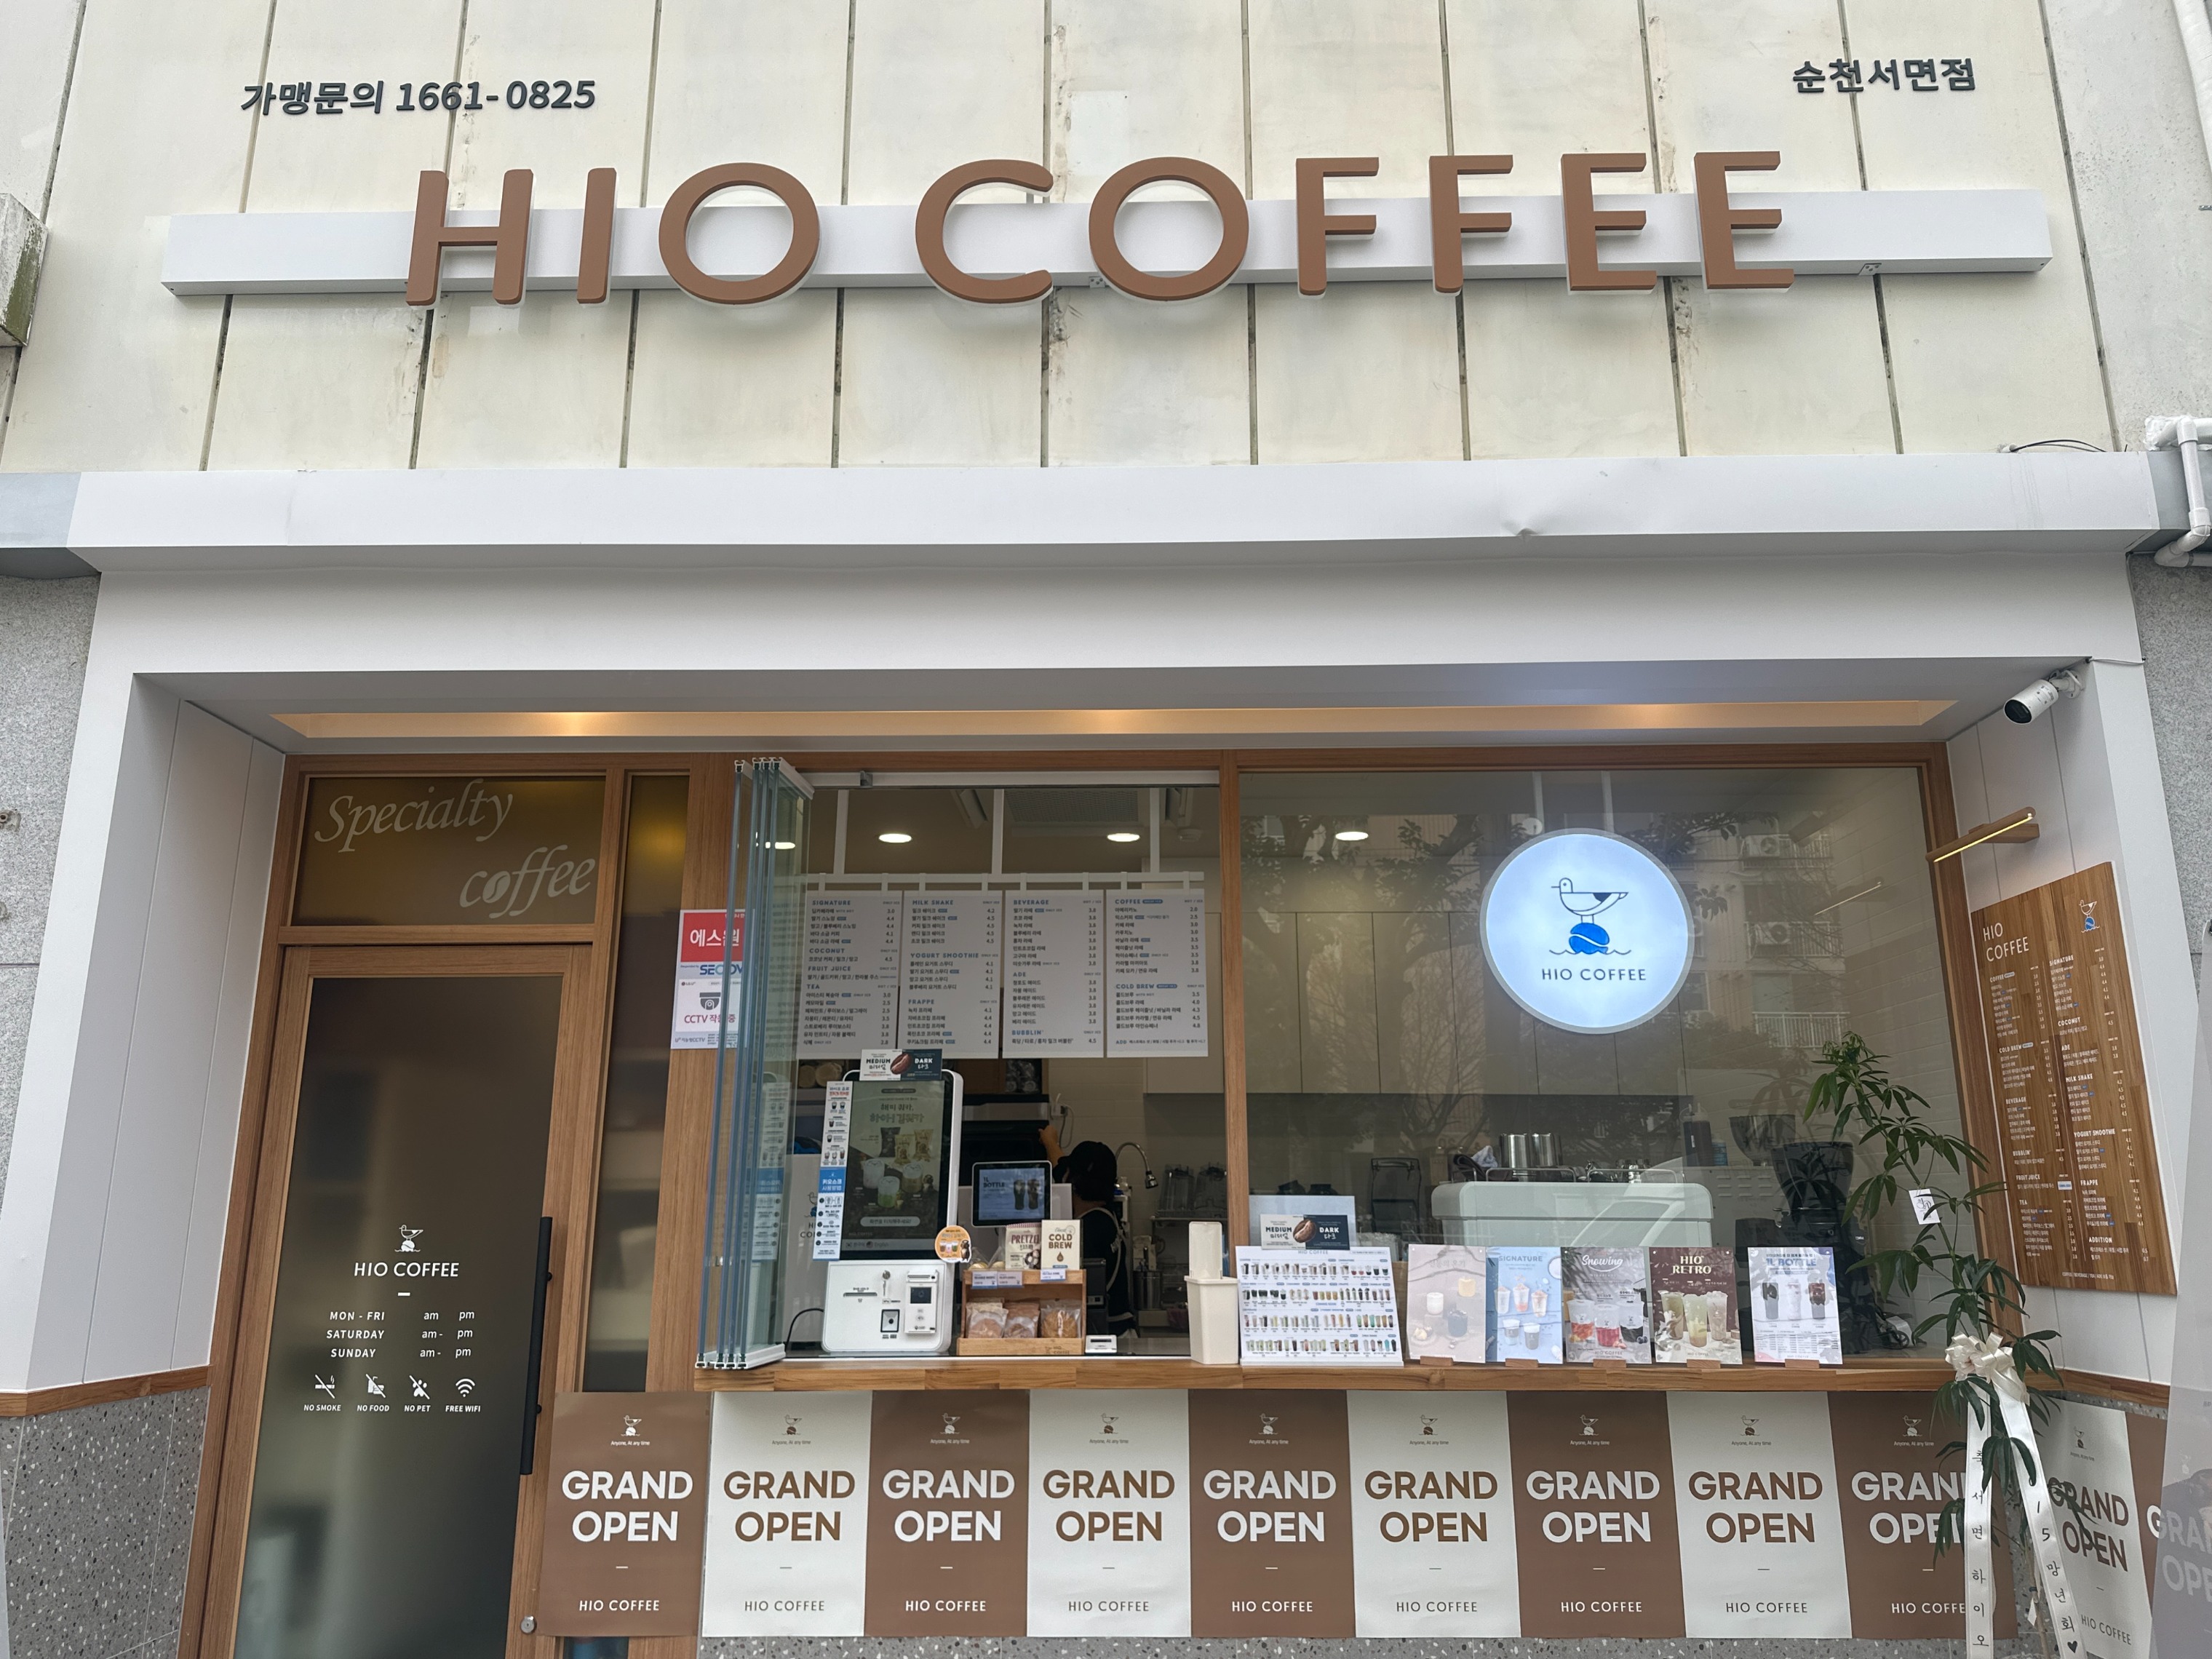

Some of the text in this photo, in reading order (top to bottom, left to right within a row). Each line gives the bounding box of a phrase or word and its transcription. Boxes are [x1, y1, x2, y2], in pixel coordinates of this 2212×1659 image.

[1792, 57, 1976, 93] 순천서면점
[240, 79, 384, 116] 가맹문의
[405, 150, 1796, 307] HIO COFFEE
[314, 778, 514, 854] Specialty
[459, 844, 596, 919] coffee
[1983, 922, 2003, 942] HIO
[1986, 936, 2029, 962] COFFEE
[2049, 955, 2074, 966] SIGNATURE
[1542, 968, 1647, 981] HIO COFFEE
[1989, 974, 2005, 983] COFFEE
[684, 1014, 736, 1024] CCTV 작중
[2058, 1017, 2081, 1027] COCONUT
[1999, 1046, 2010, 1054] COLD
[2005, 1097, 2026, 1105] BEVERAGE
[2074, 1129, 2115, 1138] YOGURT SMOOTHIE
[1049, 1233, 1073, 1241] COLD
[1049, 1241, 1073, 1249] BREW
[354, 1262, 460, 1277] HIO COFFEE
[1581, 1254, 1623, 1272] Snowing
[1673, 1265, 1711, 1274] RETRO
[1778, 1258, 1816, 1266] BOTTLE
[330, 1311, 475, 1321] MON FRI am pm
[326, 1329, 473, 1340] SATURDAY am pm
[330, 1348, 472, 1358] SUNDAY am pm
[404, 1404, 431, 1412] NO PET
[562, 1470, 693, 1500] GRAND
[723, 1470, 856, 1500] GRAND
[883, 1469, 1015, 1500] GRAND
[1043, 1469, 1175, 1499] GRAND
[1203, 1469, 1337, 1500] GRAND
[1364, 1470, 1498, 1500] GRAND
[1526, 1471, 1660, 1500] GRAND
[1688, 1471, 1823, 1500] GRAND
[1851, 1471, 1966, 1501] GRAN
[2048, 1476, 2129, 1527] GRAND
[572, 1511, 678, 1543] OPEN
[735, 1511, 841, 1542] OPEN
[894, 1510, 1001, 1543] OPEN
[1056, 1511, 1162, 1542] OPEN
[1217, 1511, 1325, 1543] OPEN
[1380, 1511, 1488, 1543] OPEN
[1542, 1511, 1651, 1543] OPEN
[1706, 1512, 1815, 1543] OPEN
[2062, 1521, 2128, 1572] OPEN
[579, 1599, 660, 1611] HIO COFFEE
[744, 1600, 825, 1612] HIO COFFEE
[905, 1599, 986, 1612] HIO COFFEE
[1068, 1600, 1150, 1612] HIO COFFEE
[1232, 1600, 1313, 1612] HIO COFFEE
[1396, 1601, 1478, 1612] HIO COFFEE
[1561, 1601, 1642, 1612] HIO COFFEE
[1726, 1602, 1808, 1613] HIO COFFEE
[1891, 1602, 1966, 1614] HIO COFFE
[2080, 1614, 2132, 1646] HIO COFFEE
